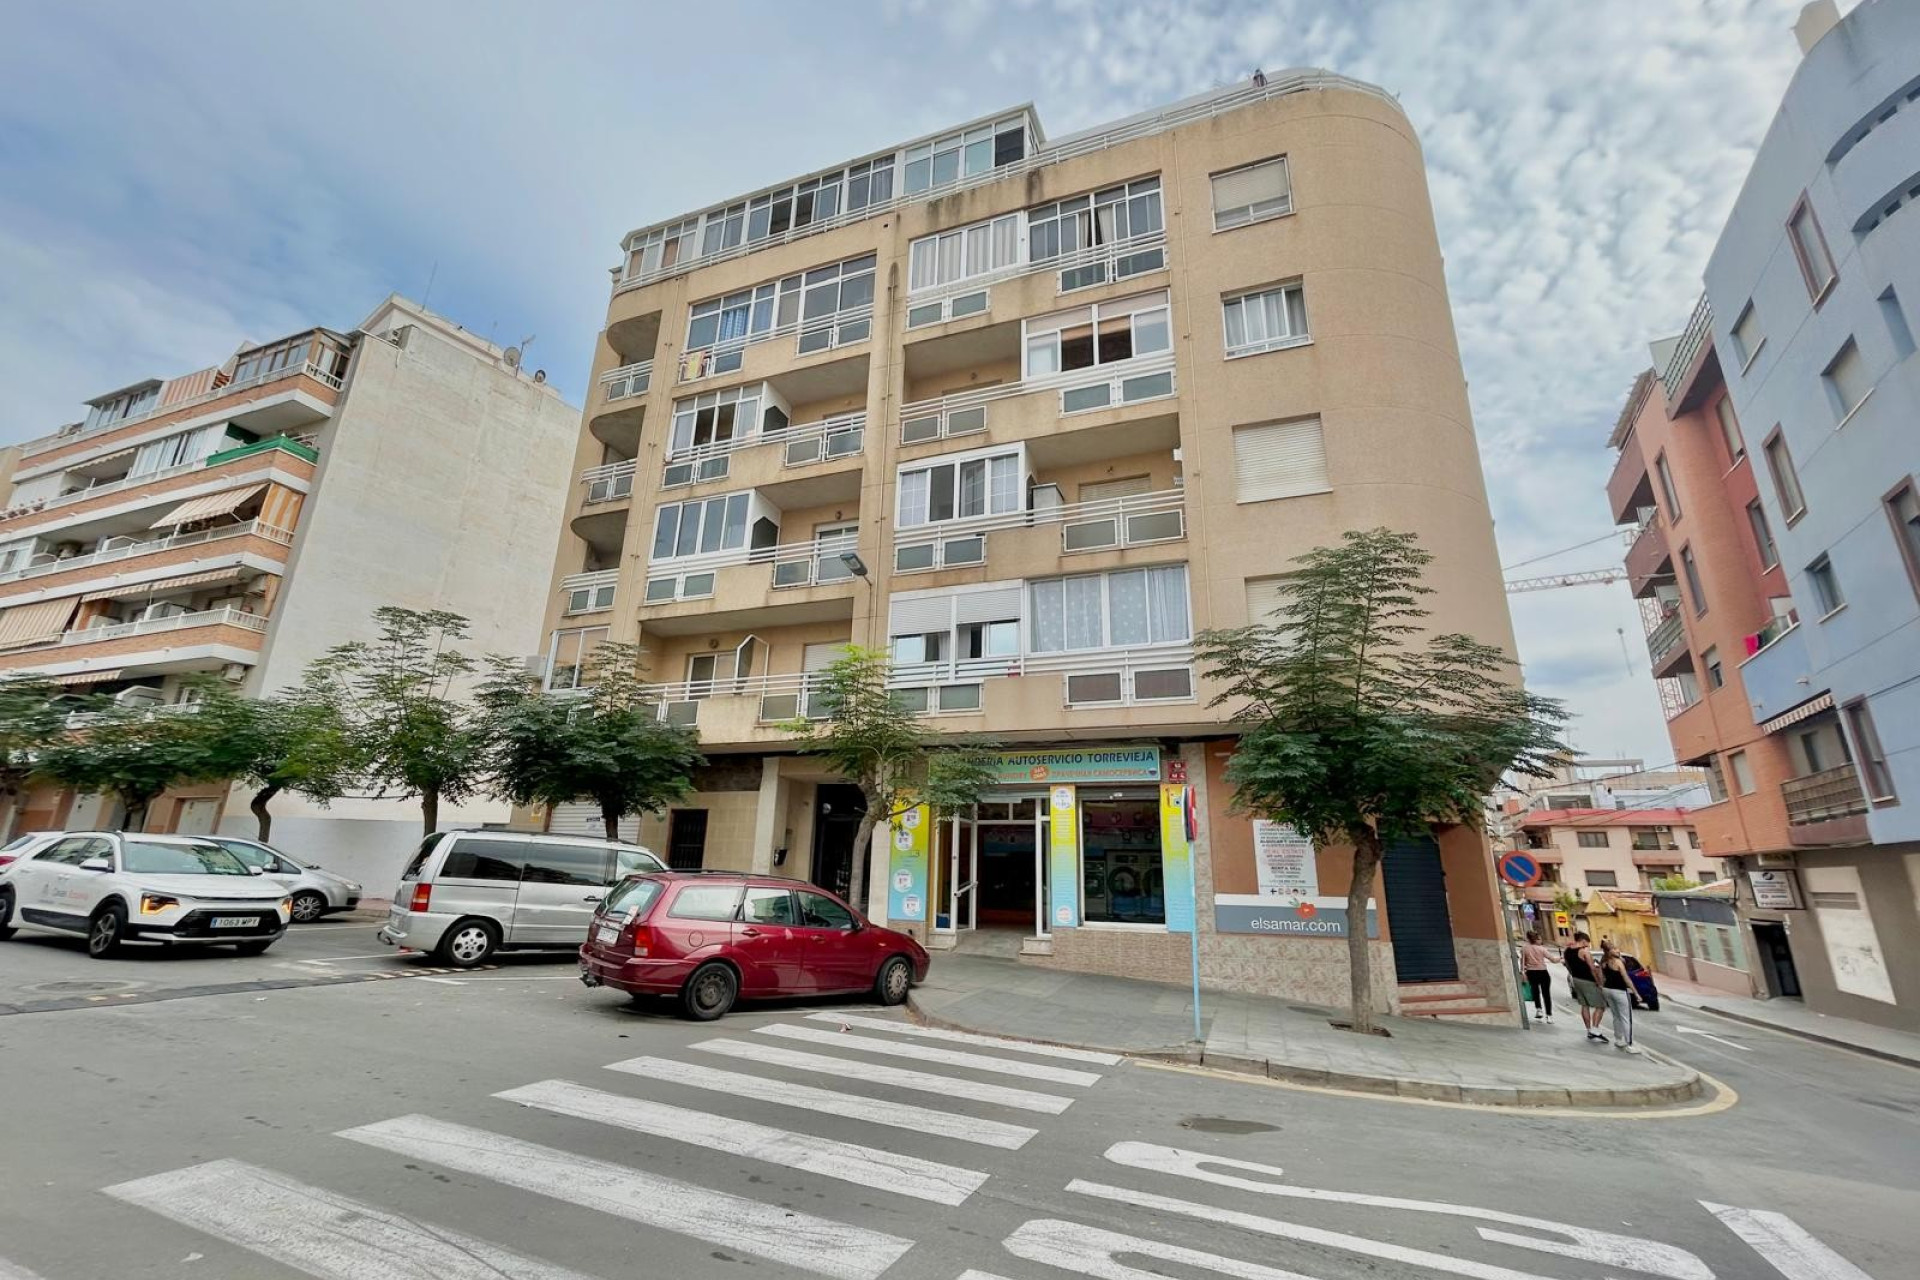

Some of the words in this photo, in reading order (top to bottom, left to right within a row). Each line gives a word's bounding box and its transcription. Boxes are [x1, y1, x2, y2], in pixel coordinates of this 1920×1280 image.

[1007, 753, 1083, 766] AUTOSERVICIO
[1087, 751, 1155, 764] TORREVIEJA
[1250, 916, 1342, 933] elsamar.com
